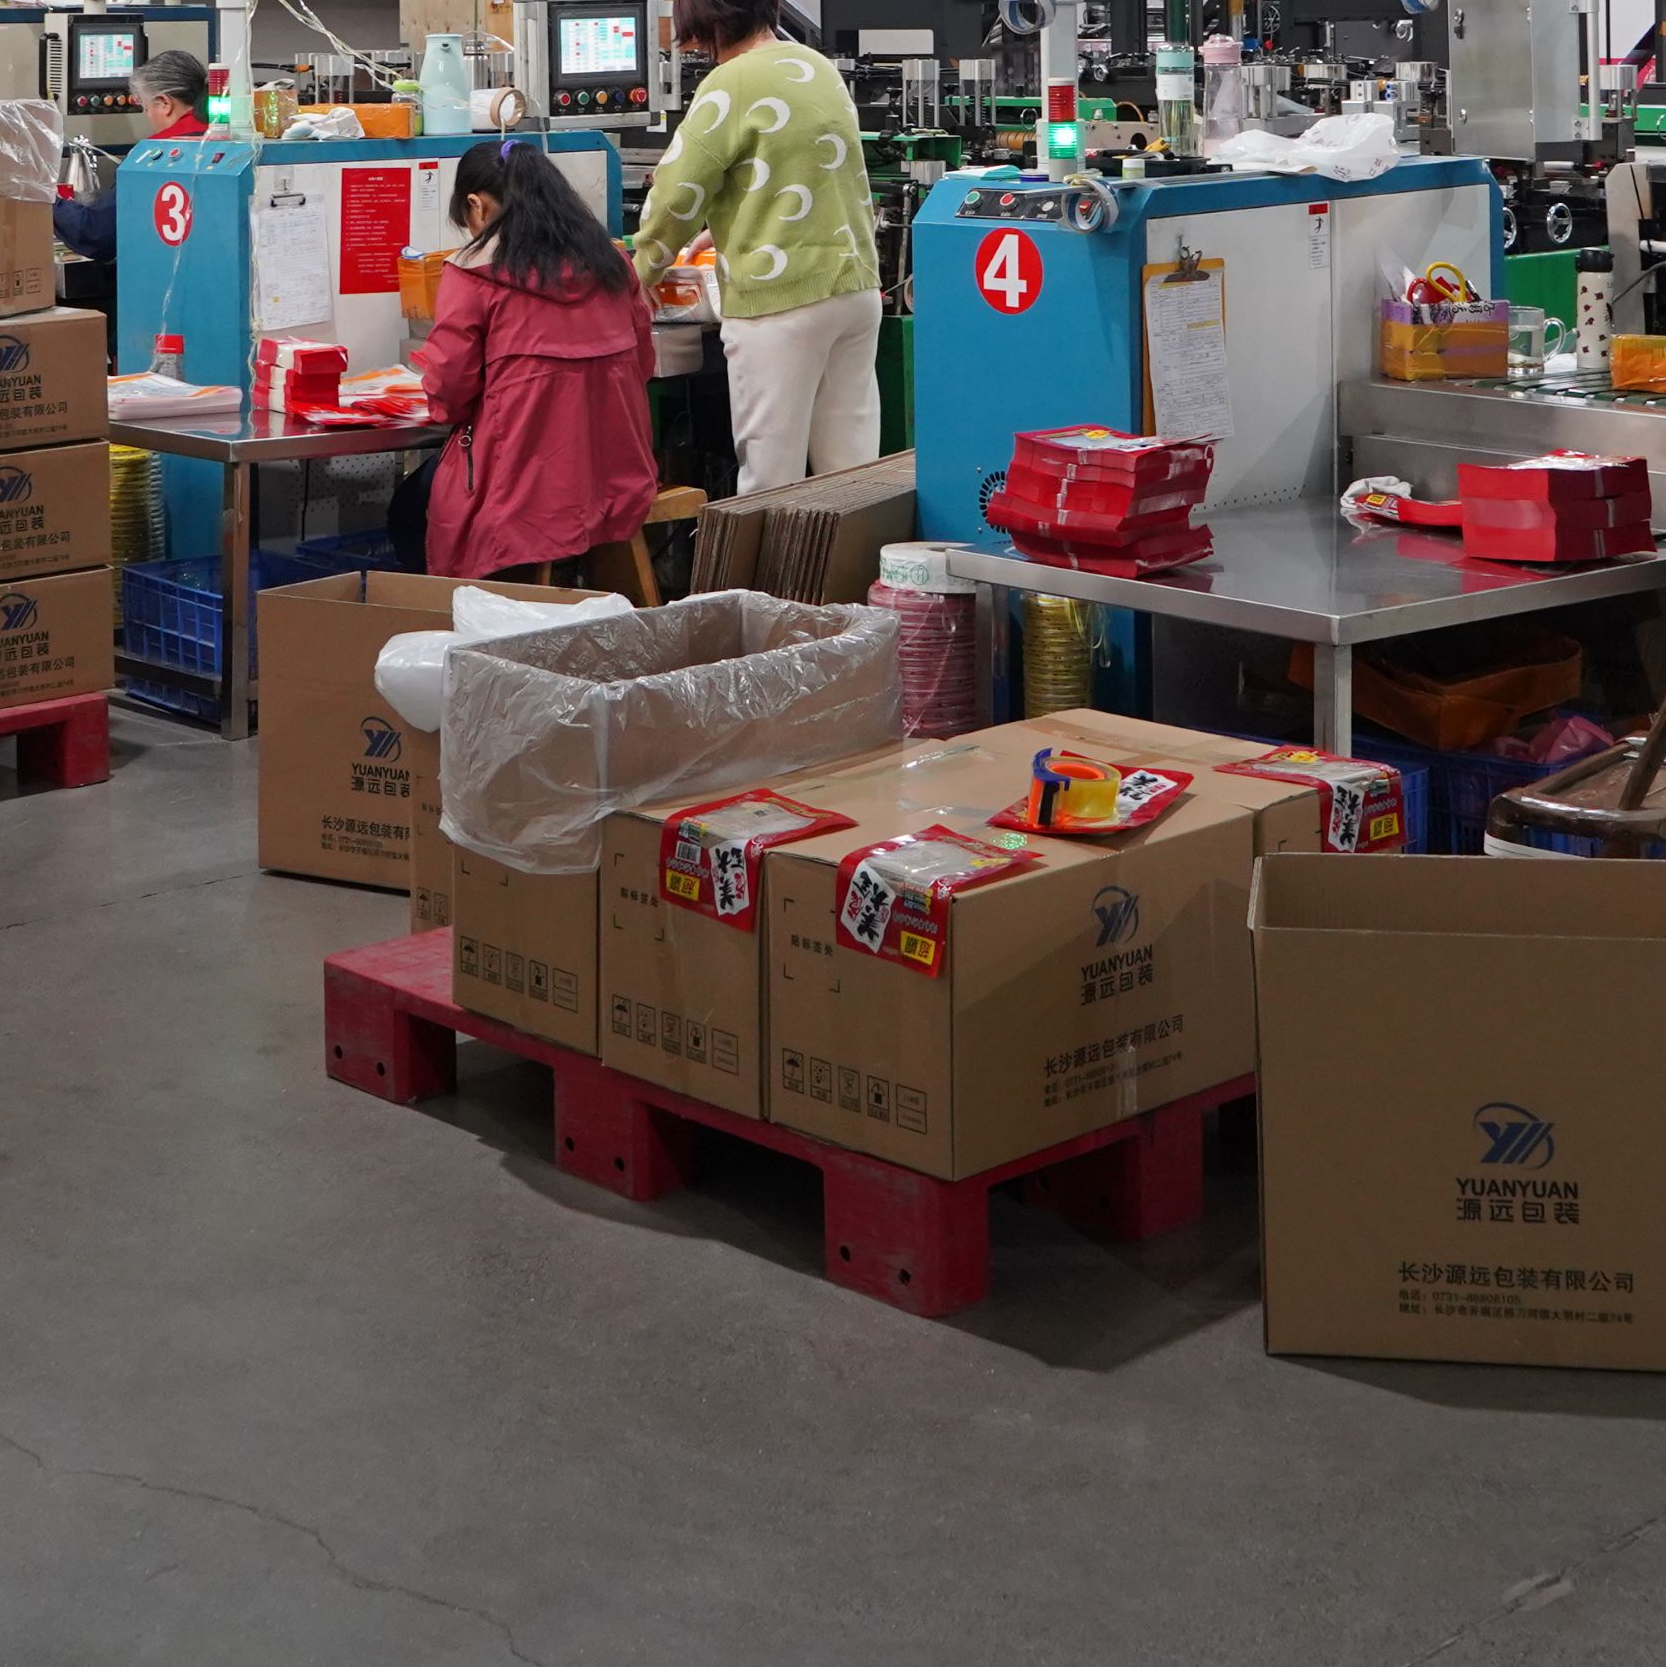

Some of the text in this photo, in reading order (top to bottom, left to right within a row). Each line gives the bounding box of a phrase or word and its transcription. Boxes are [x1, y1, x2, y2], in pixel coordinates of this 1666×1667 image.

[160, 185, 188, 243] 3
[982, 233, 1028, 309] 4
[1081, 944, 1153, 982] YUANYUAN
[1044, 1014, 1183, 1078] 长沙源远包装有限公司
[1456, 1178, 1579, 1199] YUANYUAN
[1456, 1198, 1580, 1224] 源远包装
[1398, 1261, 1635, 1293] 长沙源远包装有限公司
